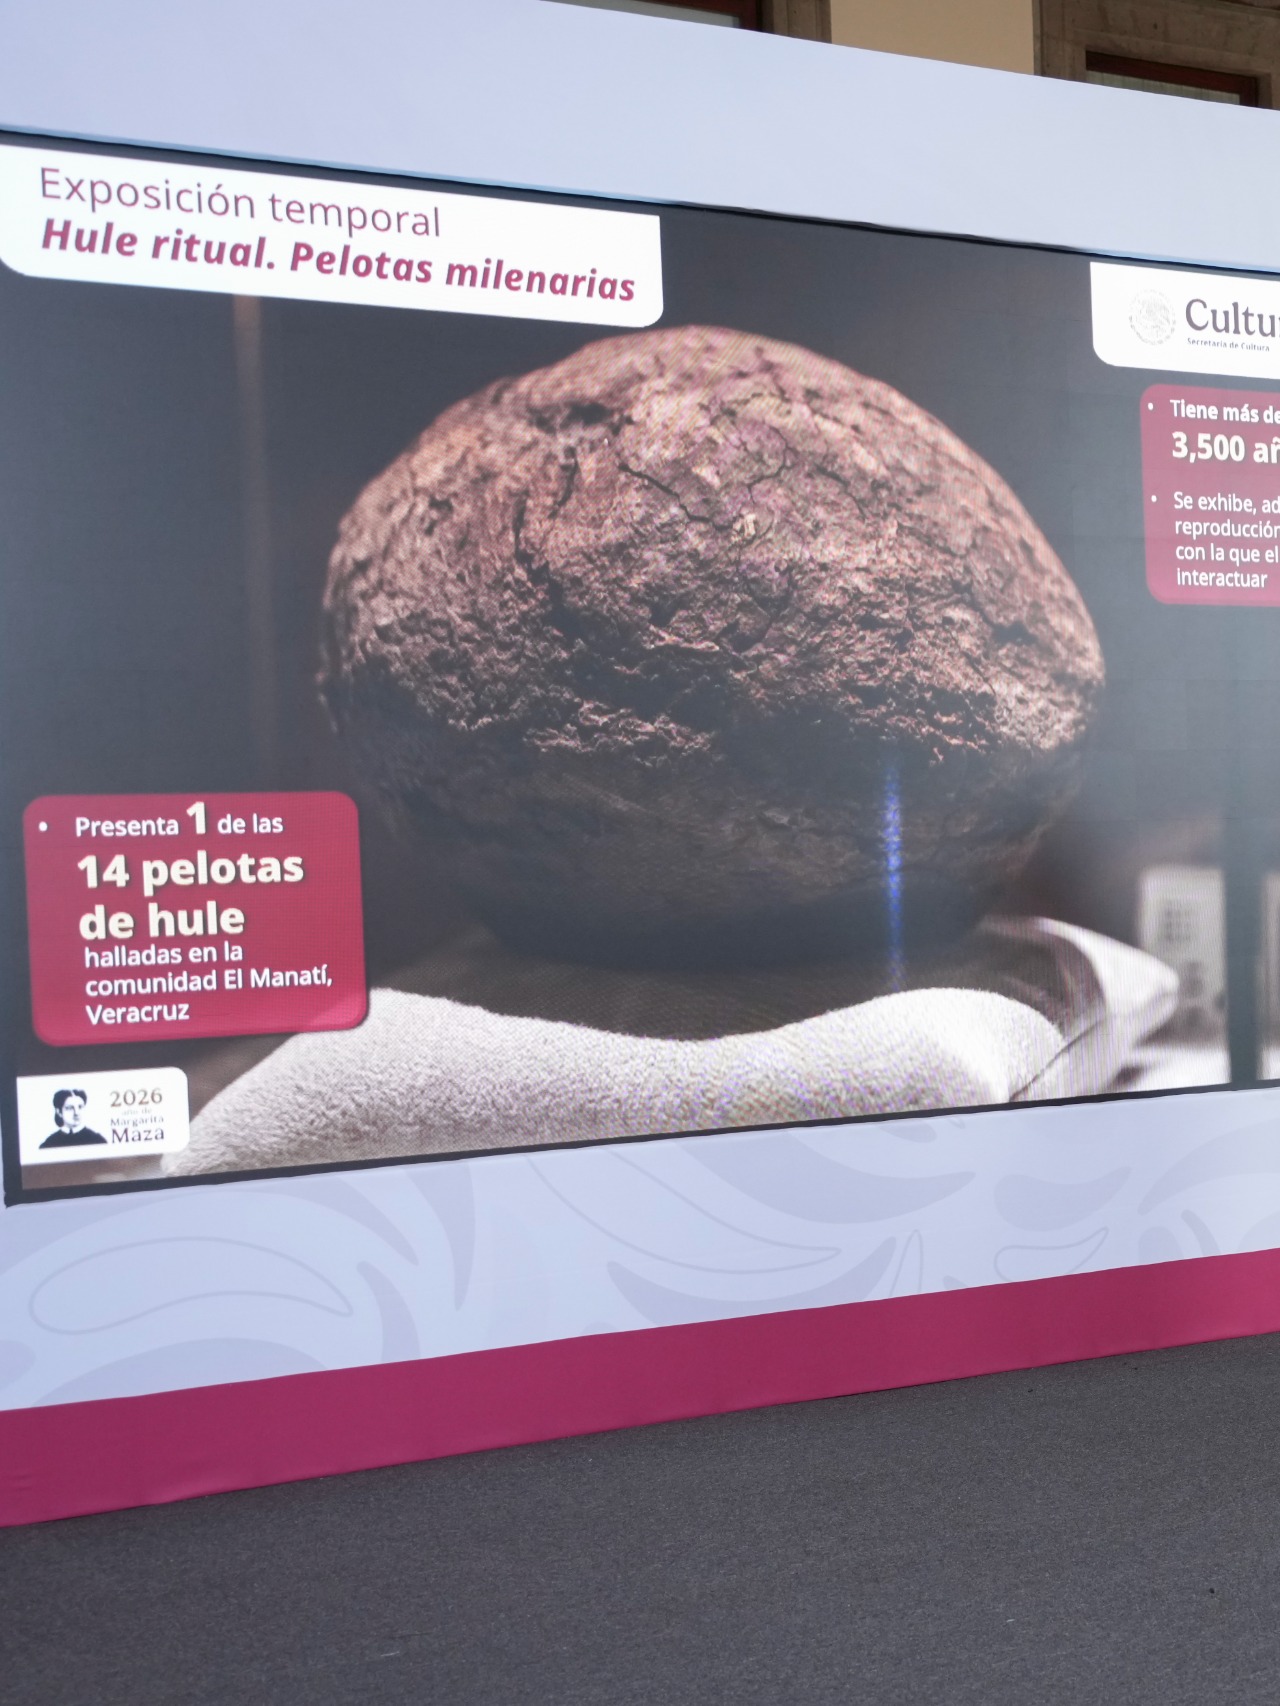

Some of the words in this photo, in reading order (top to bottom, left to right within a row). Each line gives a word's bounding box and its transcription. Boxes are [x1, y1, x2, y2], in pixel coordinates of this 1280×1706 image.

[41, 166, 256, 218] Exposición
[269, 193, 440, 238] temporal
[42, 218, 137, 256] Hule
[151, 228, 275, 269] ritual.
[290, 241, 432, 284] Pelotas
[445, 258, 636, 302] milenarias
[1170, 399, 1218, 420] Tiene
[1223, 402, 1259, 423] más
[1172, 431, 1245, 463] 3,500
[1173, 491, 1193, 510] Se
[1198, 493, 1257, 515] exhibe,
[1176, 545, 1205, 560] con
[1210, 544, 1225, 561] la
[1229, 547, 1260, 567] que
[1265, 545, 1279, 563] el
[1176, 567, 1268, 588] interactuar
[75, 816, 179, 837] Presenta
[186, 801, 206, 835] 1
[217, 814, 246, 834] de
[253, 813, 284, 833] las
[77, 854, 130, 889] 14
[142, 850, 304, 897] pelotas
[79, 904, 134, 940] de
[148, 900, 245, 938] hule
[84, 945, 182, 968] halladas
[188, 946, 217, 964] en
[224, 941, 243, 962] la
[85, 970, 217, 997] comunidad
[224, 968, 243, 990] El
[249, 963, 333, 989] Manatí,
[86, 1002, 190, 1026] Veracruz
[110, 1087, 163, 1107] 2026
[112, 1128, 165, 1144] Maza
